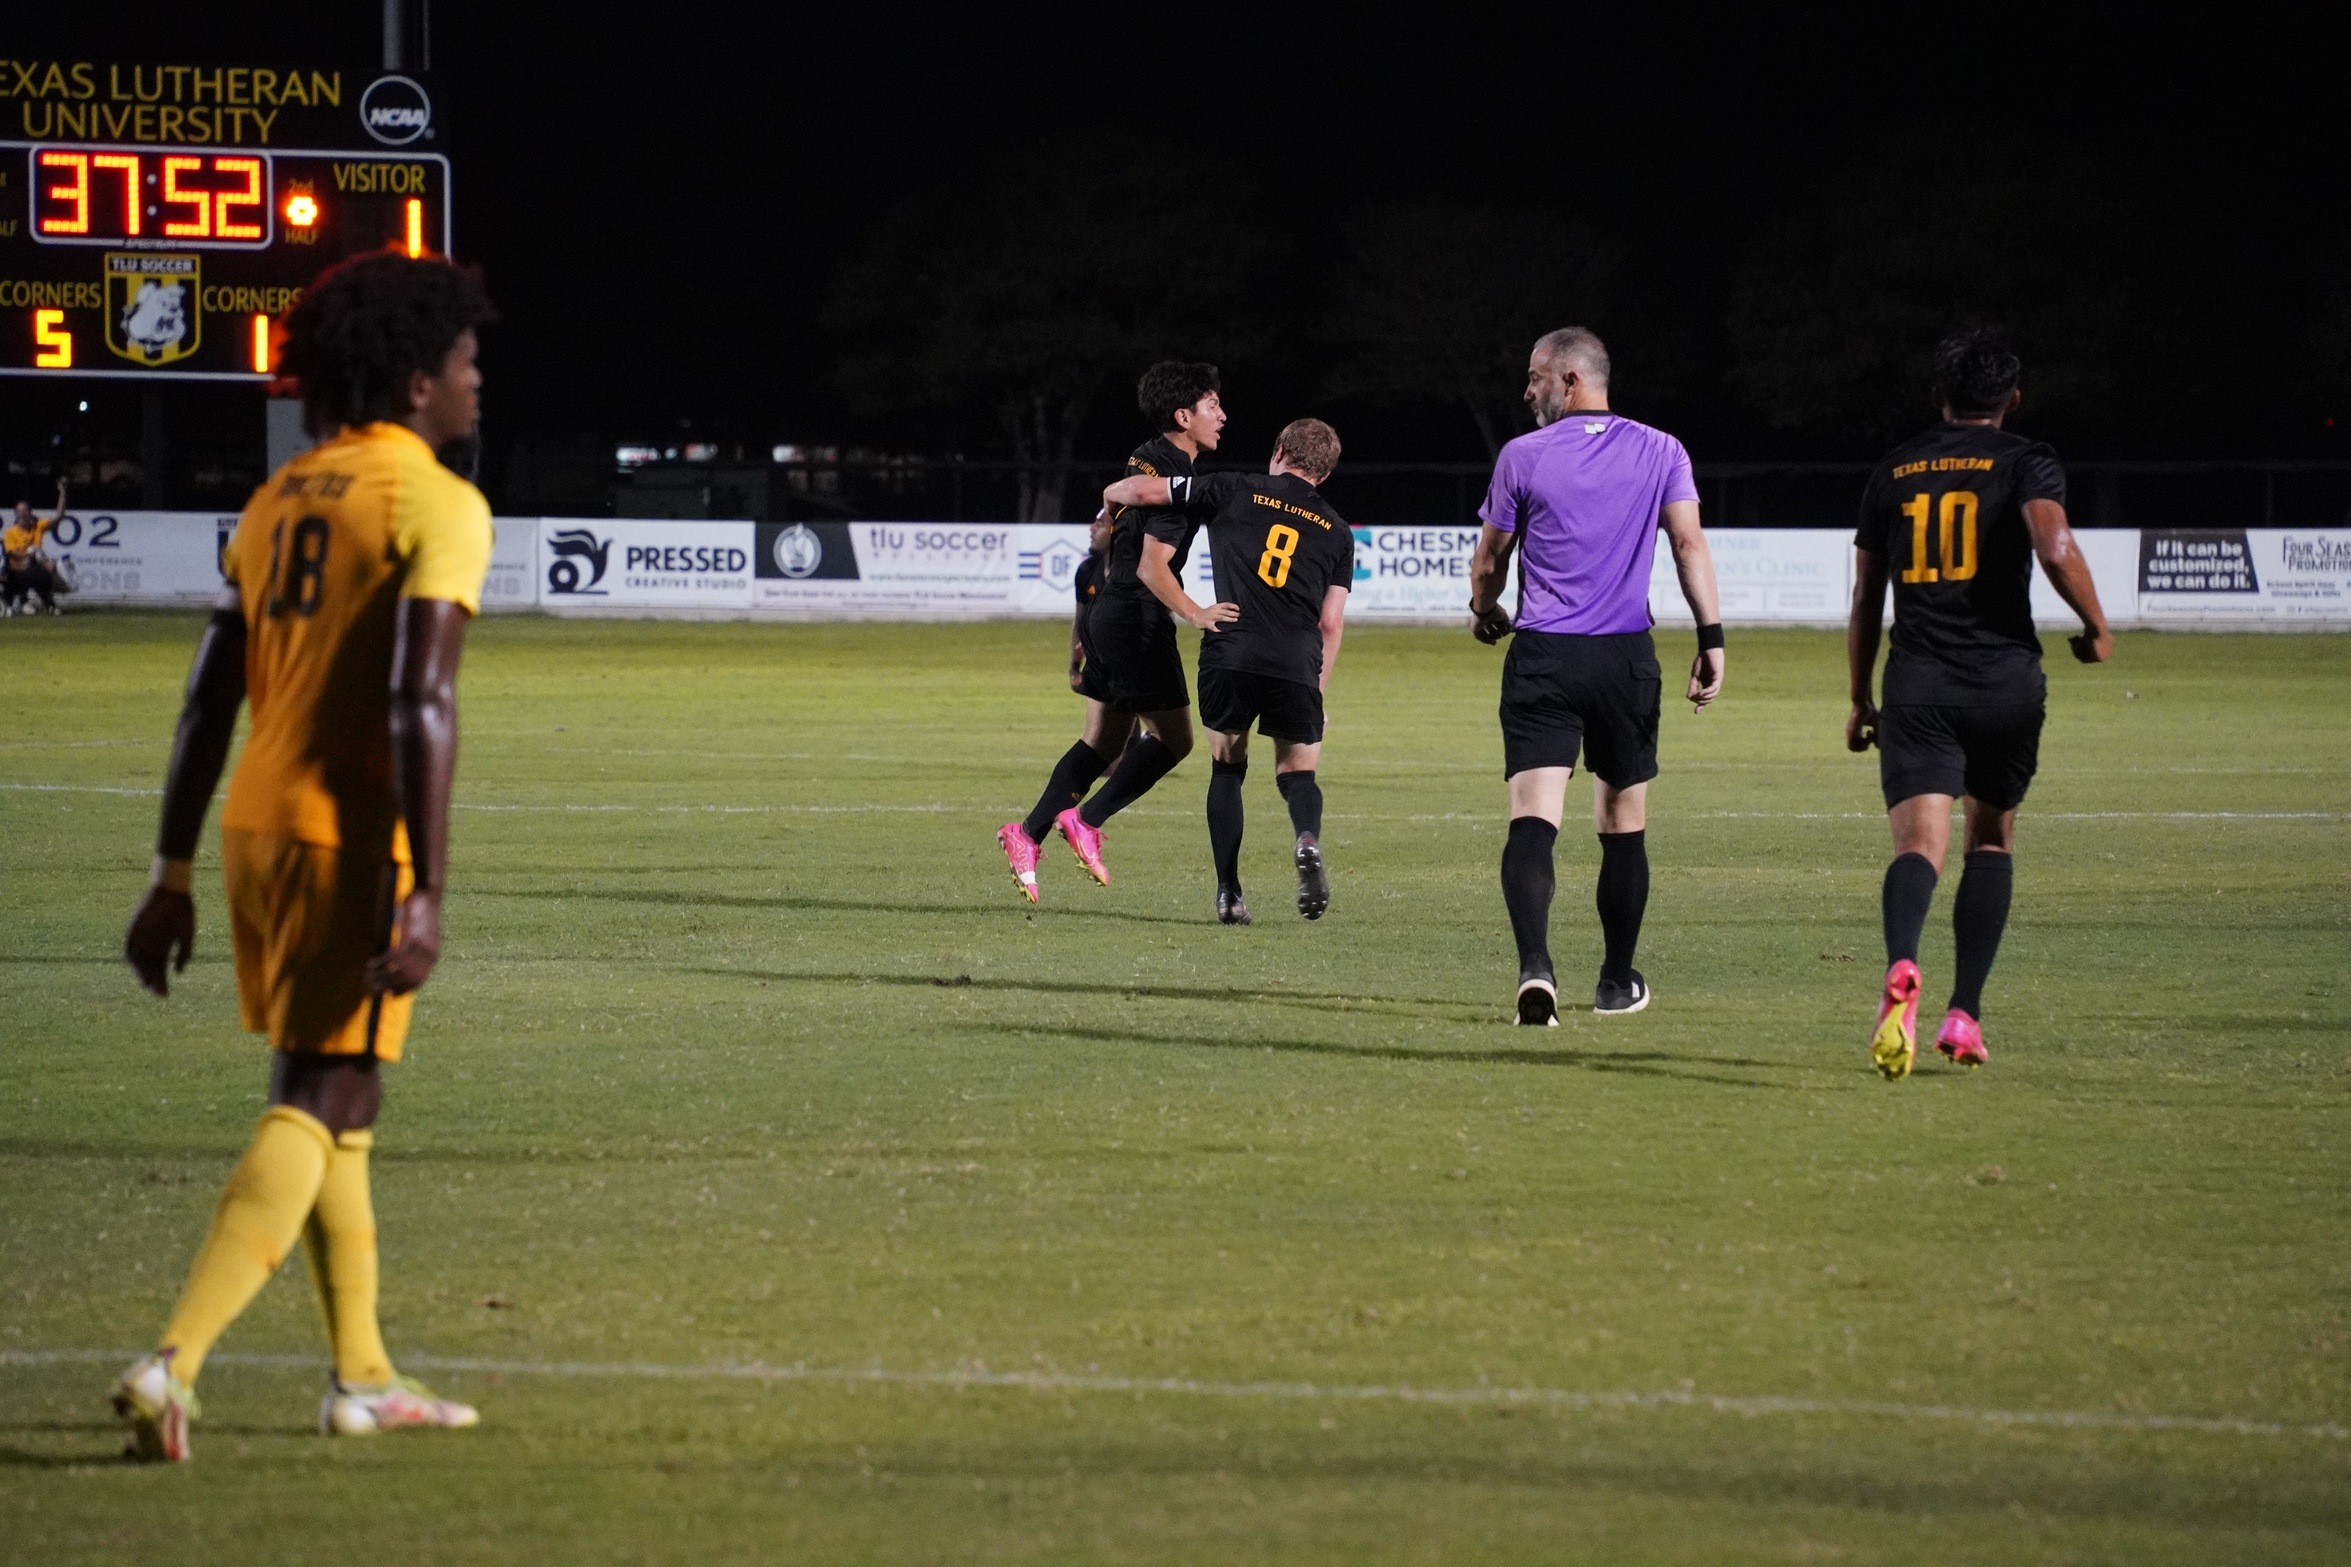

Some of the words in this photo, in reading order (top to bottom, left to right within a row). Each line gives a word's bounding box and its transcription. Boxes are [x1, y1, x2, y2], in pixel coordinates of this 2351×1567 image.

[110, 65, 341, 106] LUTHERAN
[23, 101, 278, 143] UNIVERSITY
[370, 107, 425, 126] NCAA
[333, 162, 426, 194] VISITOR
[285, 228, 318, 245] HALF
[407, 199, 422, 259] 1
[113, 258, 139, 271] TLU
[141, 259, 194, 273] SOCCER
[1, 280, 101, 309] CORNERS
[36, 309, 72, 368] 5
[255, 314, 269, 373] 1
[1892, 460, 1928, 479] TEXAS
[1930, 456, 1995, 472] LUTHERAN
[1252, 493, 1282, 510] TEXAS
[1284, 503, 1332, 531] LUTHERAN
[869, 527, 904, 549] tlu
[914, 529, 1008, 550] soccer
[1379, 532, 1479, 552] CHESM
[1901, 490, 1979, 584] 10
[2156, 540, 2169, 557] If
[2172, 540, 2184, 557] it
[2187, 543, 2218, 557] can
[2221, 540, 2244, 557] be
[267, 514, 331, 618] 18
[627, 546, 747, 572] PRESSED
[1257, 523, 1300, 589] 8
[1380, 557, 1473, 578] HOME
[2149, 557, 2250, 574] customized,
[2288, 553, 2351, 573] PROMOTIO
[2147, 575, 2173, 589] we
[2175, 575, 2206, 589] can
[2208, 573, 2232, 589] do
[2234, 573, 2251, 589] it.
